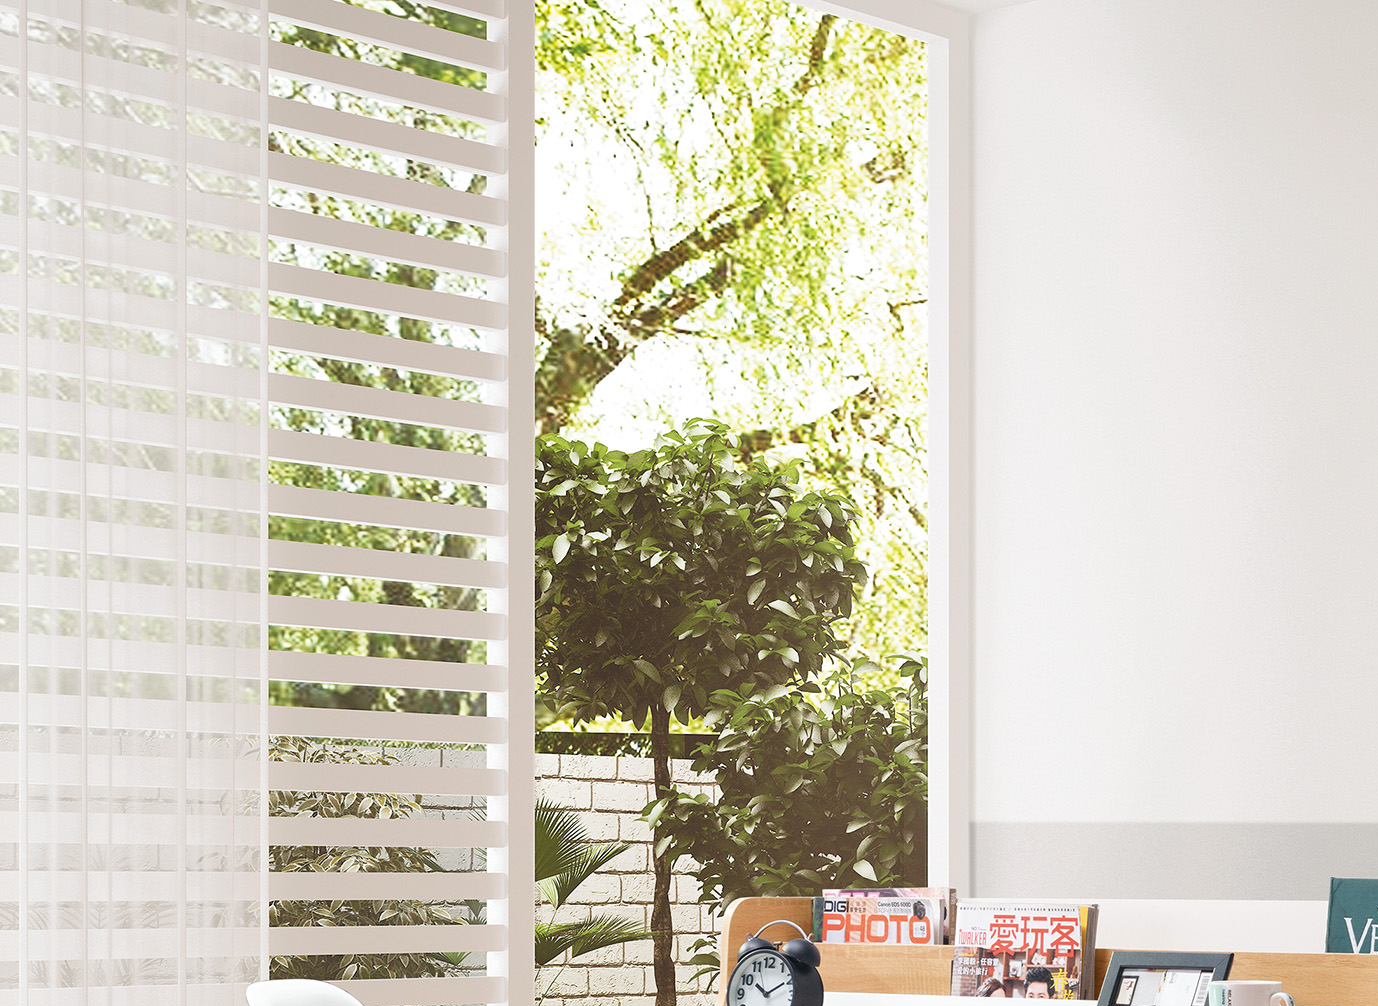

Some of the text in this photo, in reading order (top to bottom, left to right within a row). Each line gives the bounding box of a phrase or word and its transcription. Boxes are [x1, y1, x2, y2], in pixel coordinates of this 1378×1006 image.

[824, 901, 849, 912] DIGI
[822, 914, 931, 944] PHOTO
[990, 914, 1079, 957] 愛玩客
[752, 961, 762, 972] 11
[764, 957, 775, 968] 12
[780, 962, 785, 973] 1
[741, 974, 754, 986] 10
[786, 974, 793, 985] 2
[737, 988, 745, 1000] 9
